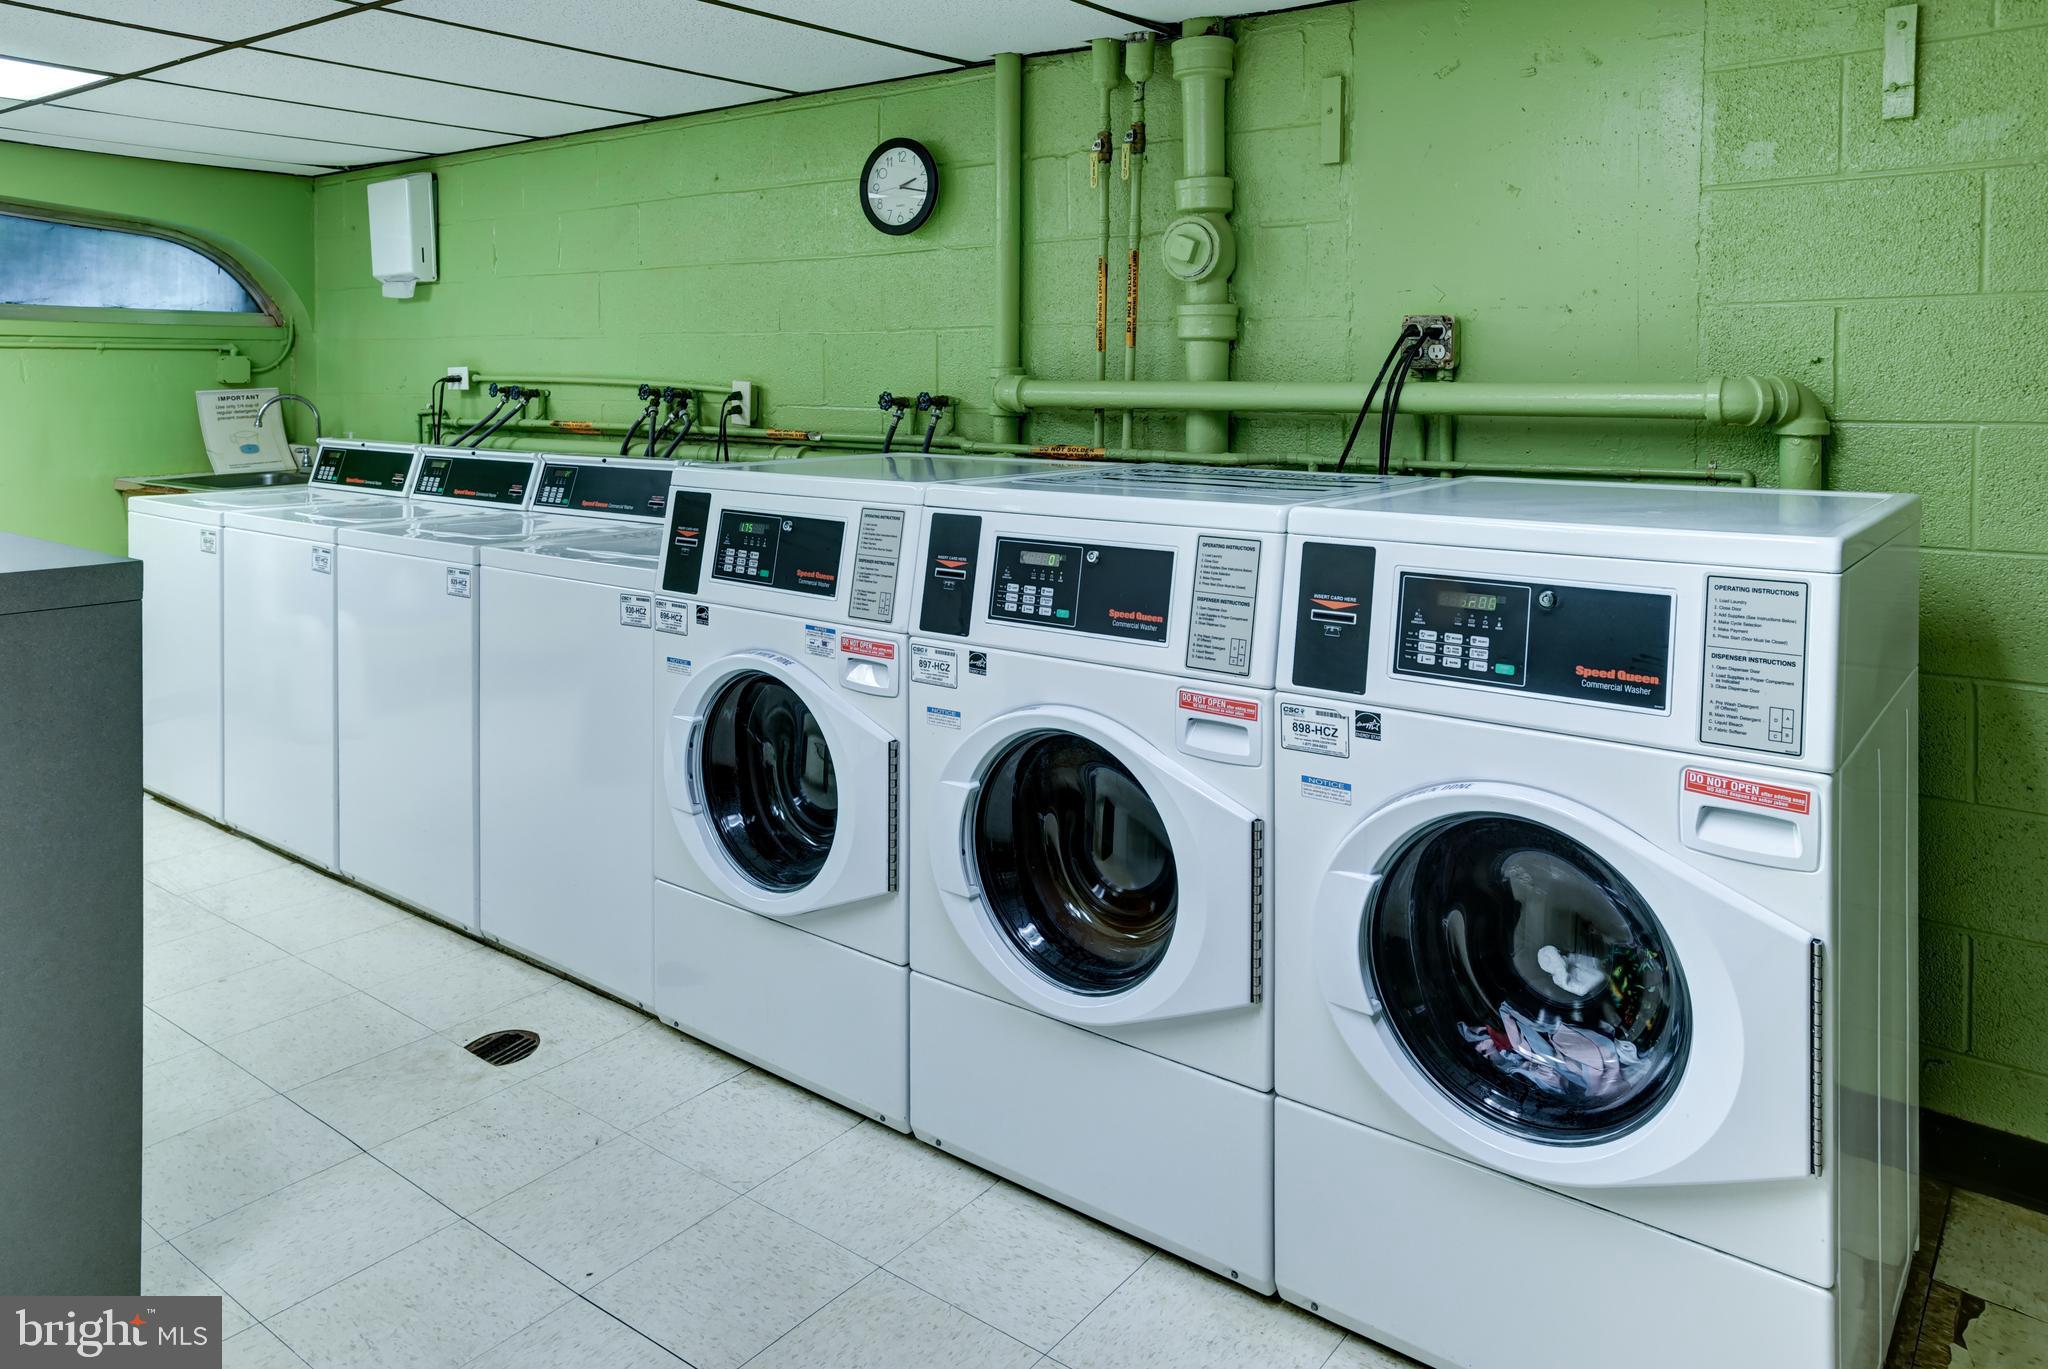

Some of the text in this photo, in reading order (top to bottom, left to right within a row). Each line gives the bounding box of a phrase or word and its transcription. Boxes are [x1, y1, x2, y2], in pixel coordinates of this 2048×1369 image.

[886, 157, 893, 167] 11
[899, 151, 906, 162] 12
[876, 168, 887, 179] 10
[873, 183, 880, 194] 9
[877, 199, 883, 209] 8
[888, 210, 892, 221] 7
[897, 211, 903, 223] 6
[797, 569, 834, 580] Speed Queen
[1714, 585, 1799, 597] OPERATING INSTRUCTIONS
[1221, 599, 1250, 607] INSTRUCTIONS
[625, 606, 647, 615] 930-HCZ
[1109, 609, 1163, 623] Speed Queen
[660, 612, 682, 622] 896-HCZ
[1112, 620, 1158, 632] Commercial Washer
[851, 639, 860, 647] NOT
[860, 641, 872, 649] OPEN
[1711, 652, 1796, 666] DISPENSER INSTRUCTIONS
[919, 659, 950, 672] 897-HCZ
[1575, 665, 1660, 685] Speed Queen
[1581, 679, 1651, 695] Commercial Washer
[1766, 678, 1794, 686] Compartment
[1728, 685, 1748, 693] Dispenser
[1182, 693, 1226, 708] DO NOT OPEN
[1283, 706, 1299, 714] CSC
[1740, 715, 1761, 723] Detergent
[1292, 722, 1338, 738] 898-HCZ
[1308, 777, 1345, 789] NOTICE
[1690, 773, 1704, 784] DO
[1707, 776, 1728, 788] NOT
[1730, 781, 1760, 795] OPEN
[1774, 794, 1791, 802] adding
